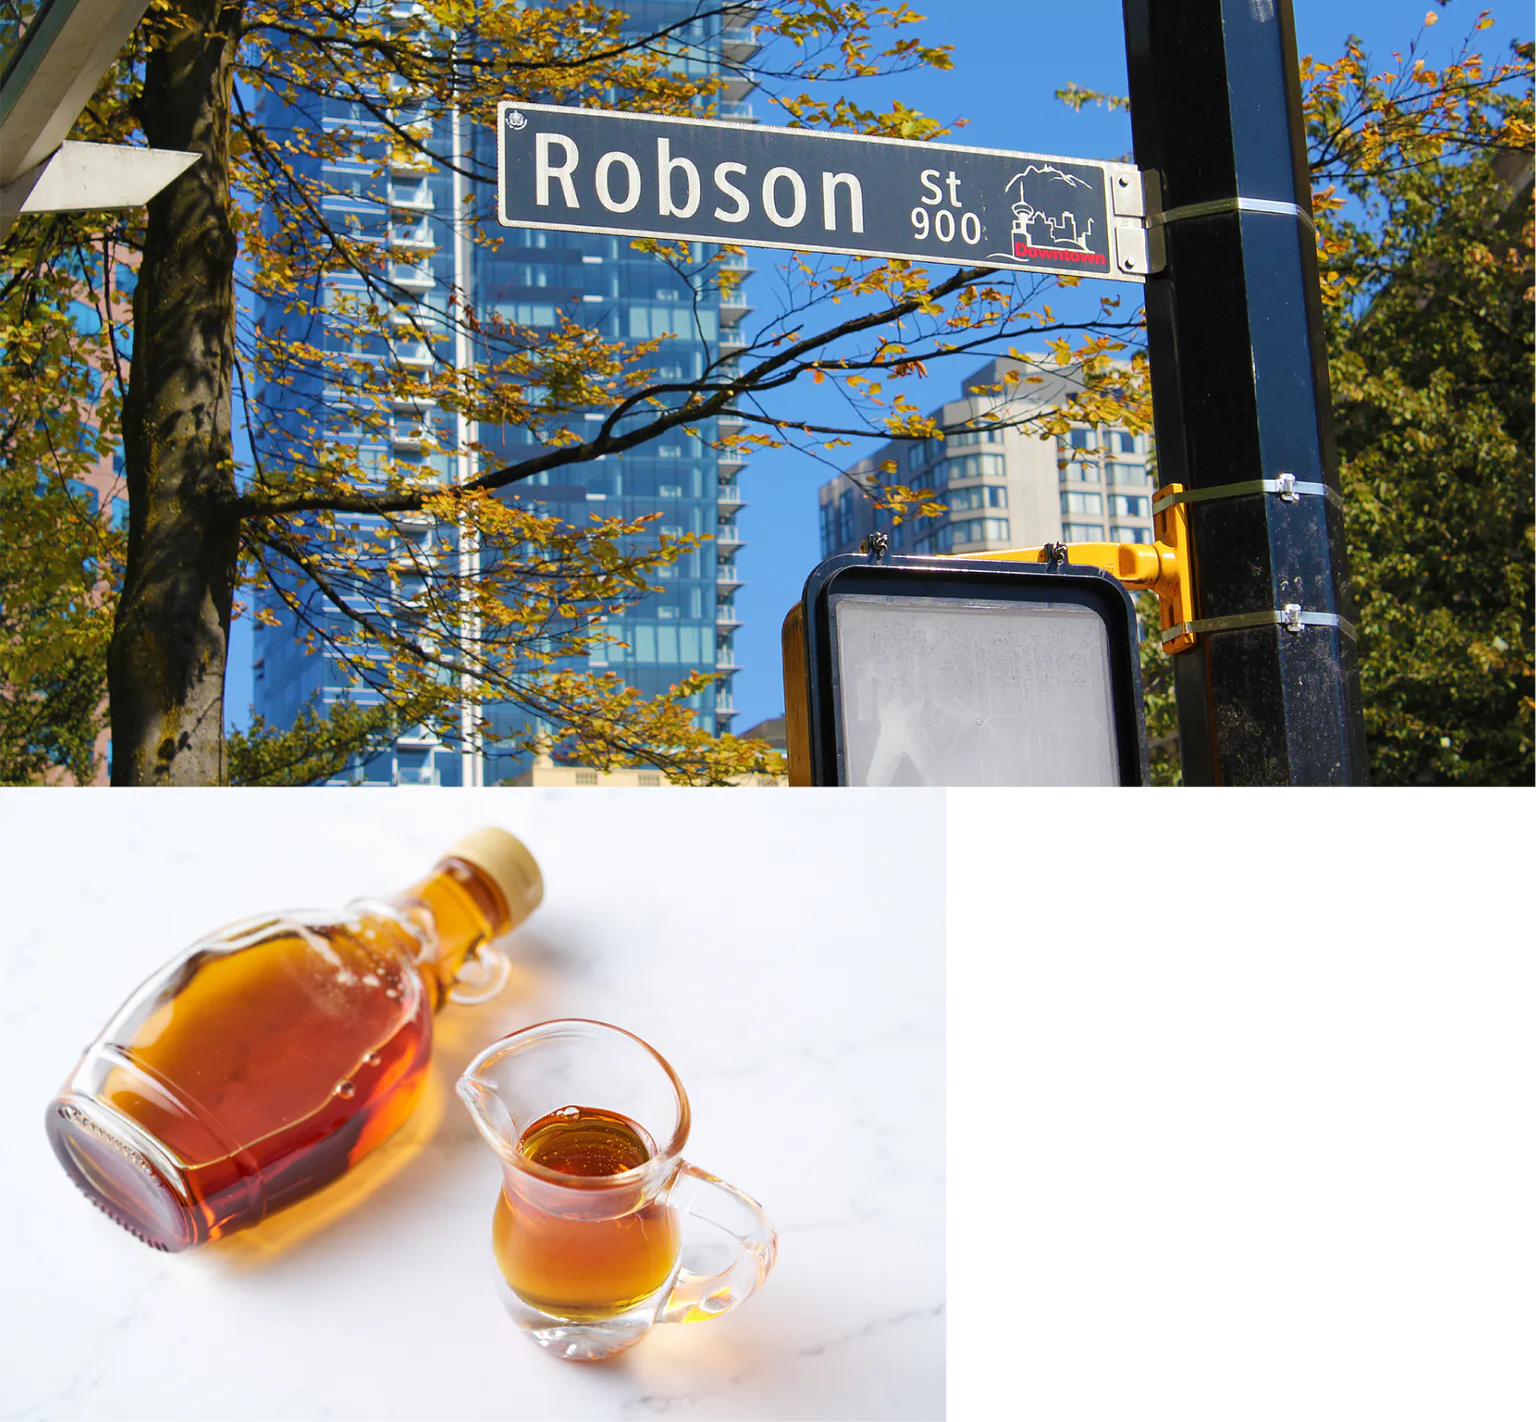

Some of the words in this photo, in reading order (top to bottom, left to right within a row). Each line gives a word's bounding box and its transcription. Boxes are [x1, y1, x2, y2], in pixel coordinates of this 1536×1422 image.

[535, 131, 864, 234] Robson
[920, 169, 963, 208] St
[911, 207, 981, 245] 900
[1014, 241, 1107, 265] Downtown
